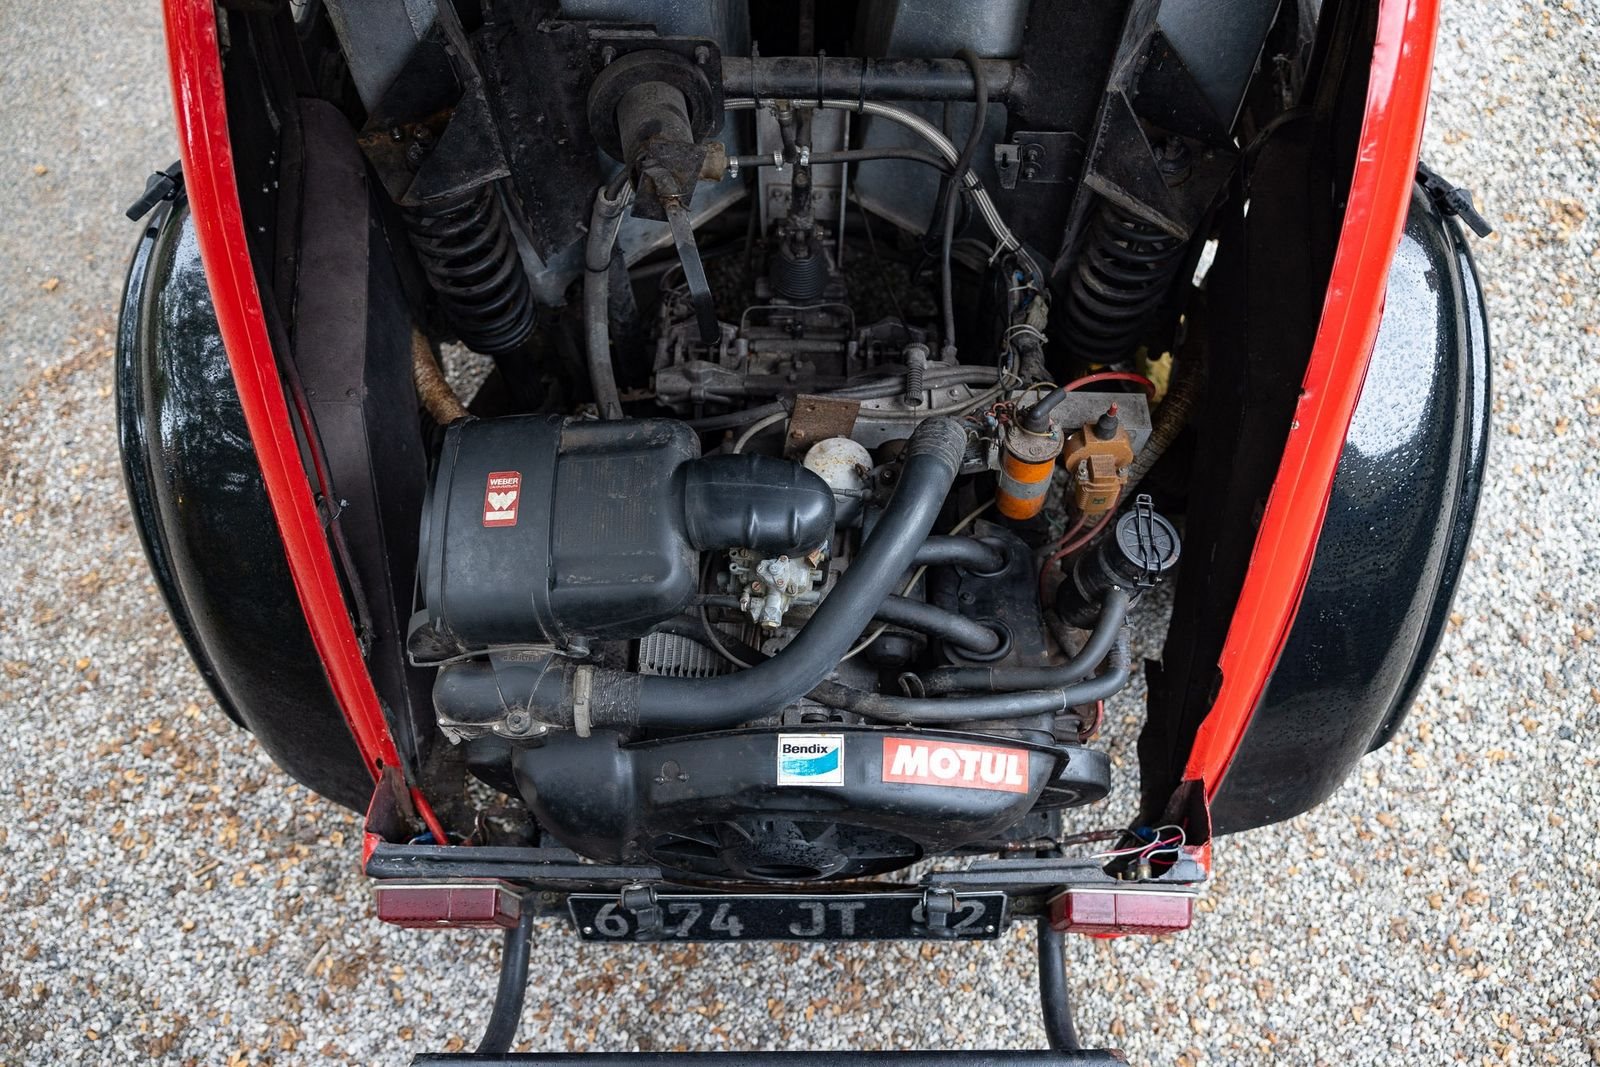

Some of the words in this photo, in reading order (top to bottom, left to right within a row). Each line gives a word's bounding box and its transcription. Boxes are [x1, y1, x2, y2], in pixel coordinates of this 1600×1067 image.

[490, 477, 519, 486] WEBER
[782, 743, 828, 754] Bendix
[890, 744, 1024, 785] MOTUL
[594, 902, 745, 937] 674
[788, 901, 866, 936] JT
